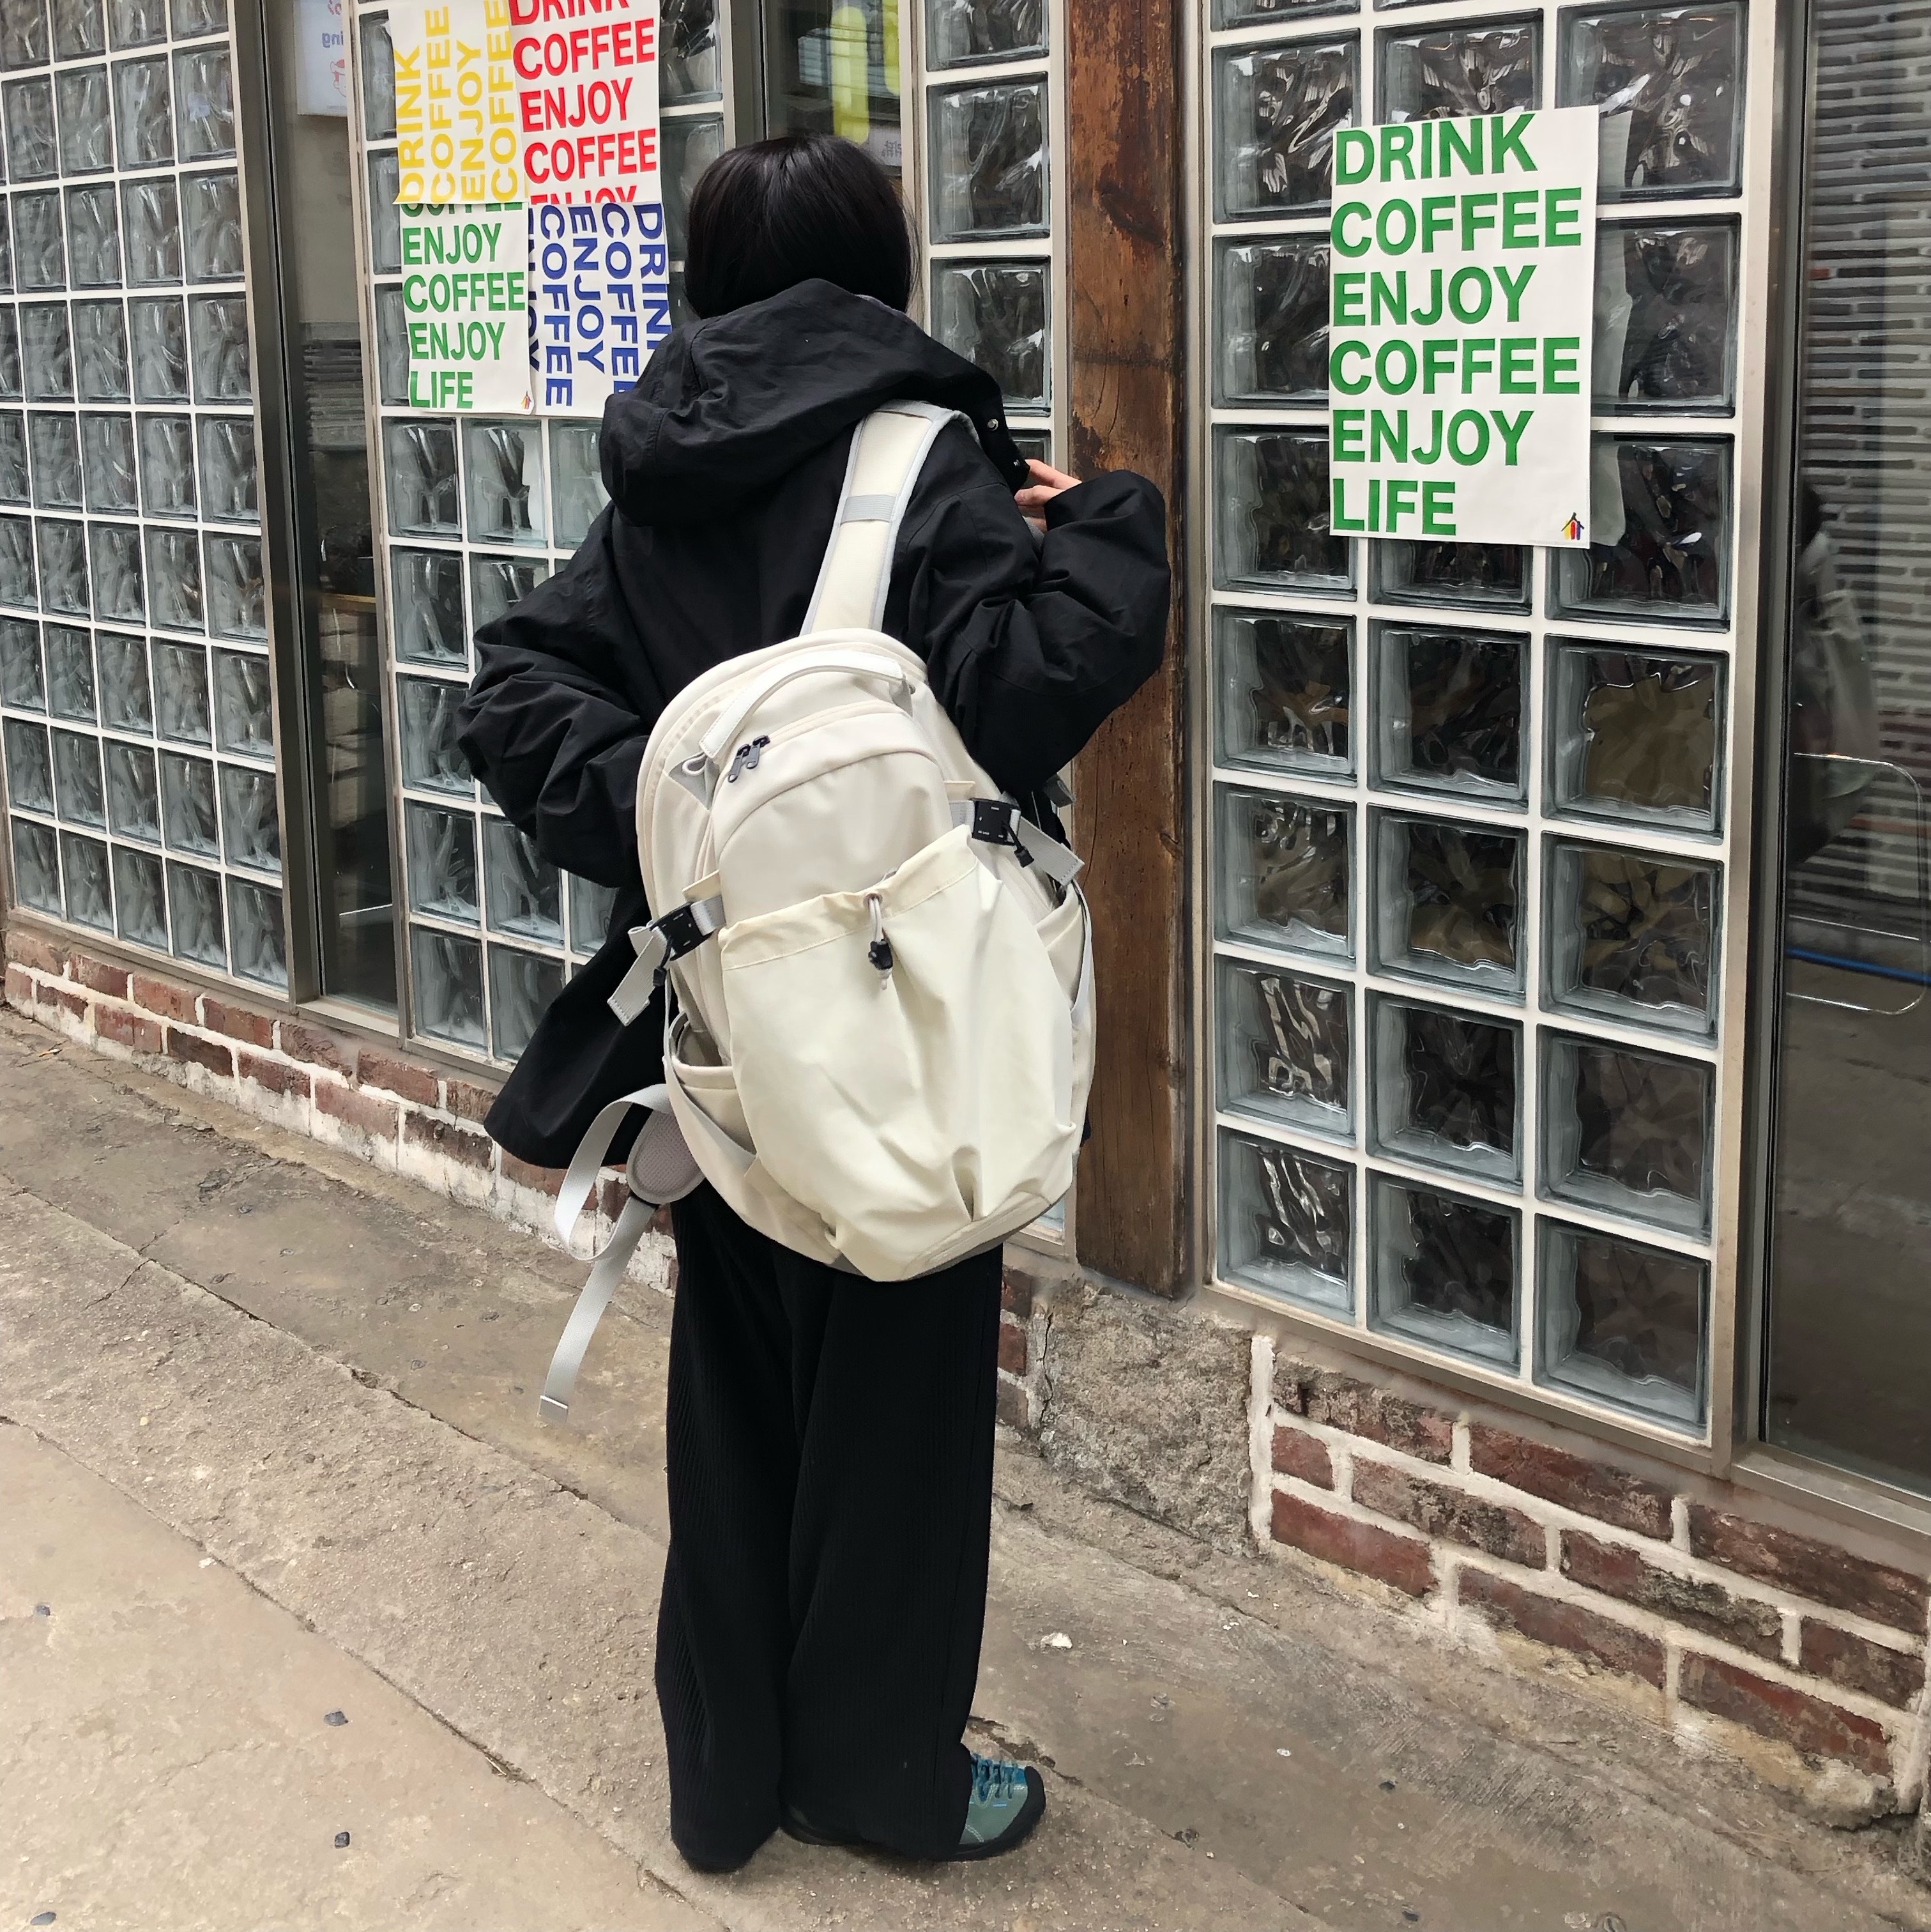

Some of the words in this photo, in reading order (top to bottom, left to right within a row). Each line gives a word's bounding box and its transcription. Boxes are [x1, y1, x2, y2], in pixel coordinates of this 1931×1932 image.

[514, 19, 654, 79] COFFEE
[394, 45, 425, 203] DRINK
[425, 6, 456, 203] COFFEE
[457, 41, 485, 200] ENJOY
[484, 0, 516, 202] COFFEE
[521, 77, 632, 132] ENJOY
[524, 128, 656, 183] COFFEE
[1336, 113, 1537, 185] DRINK
[404, 224, 500, 263] ENJOY
[1331, 187, 1582, 257] COFFEE
[404, 271, 525, 312] COFFEE
[540, 204, 573, 406] COFFEE
[568, 206, 605, 373] ENJOY
[633, 203, 672, 349] DRIN
[1333, 264, 1536, 326] ENJOY
[410, 322, 504, 358] ENJOY
[1331, 337, 1579, 394] COFFEE
[411, 371, 473, 408] LIFE
[1333, 409, 1534, 466] ENJOY
[1332, 478, 1456, 536] LIFE
